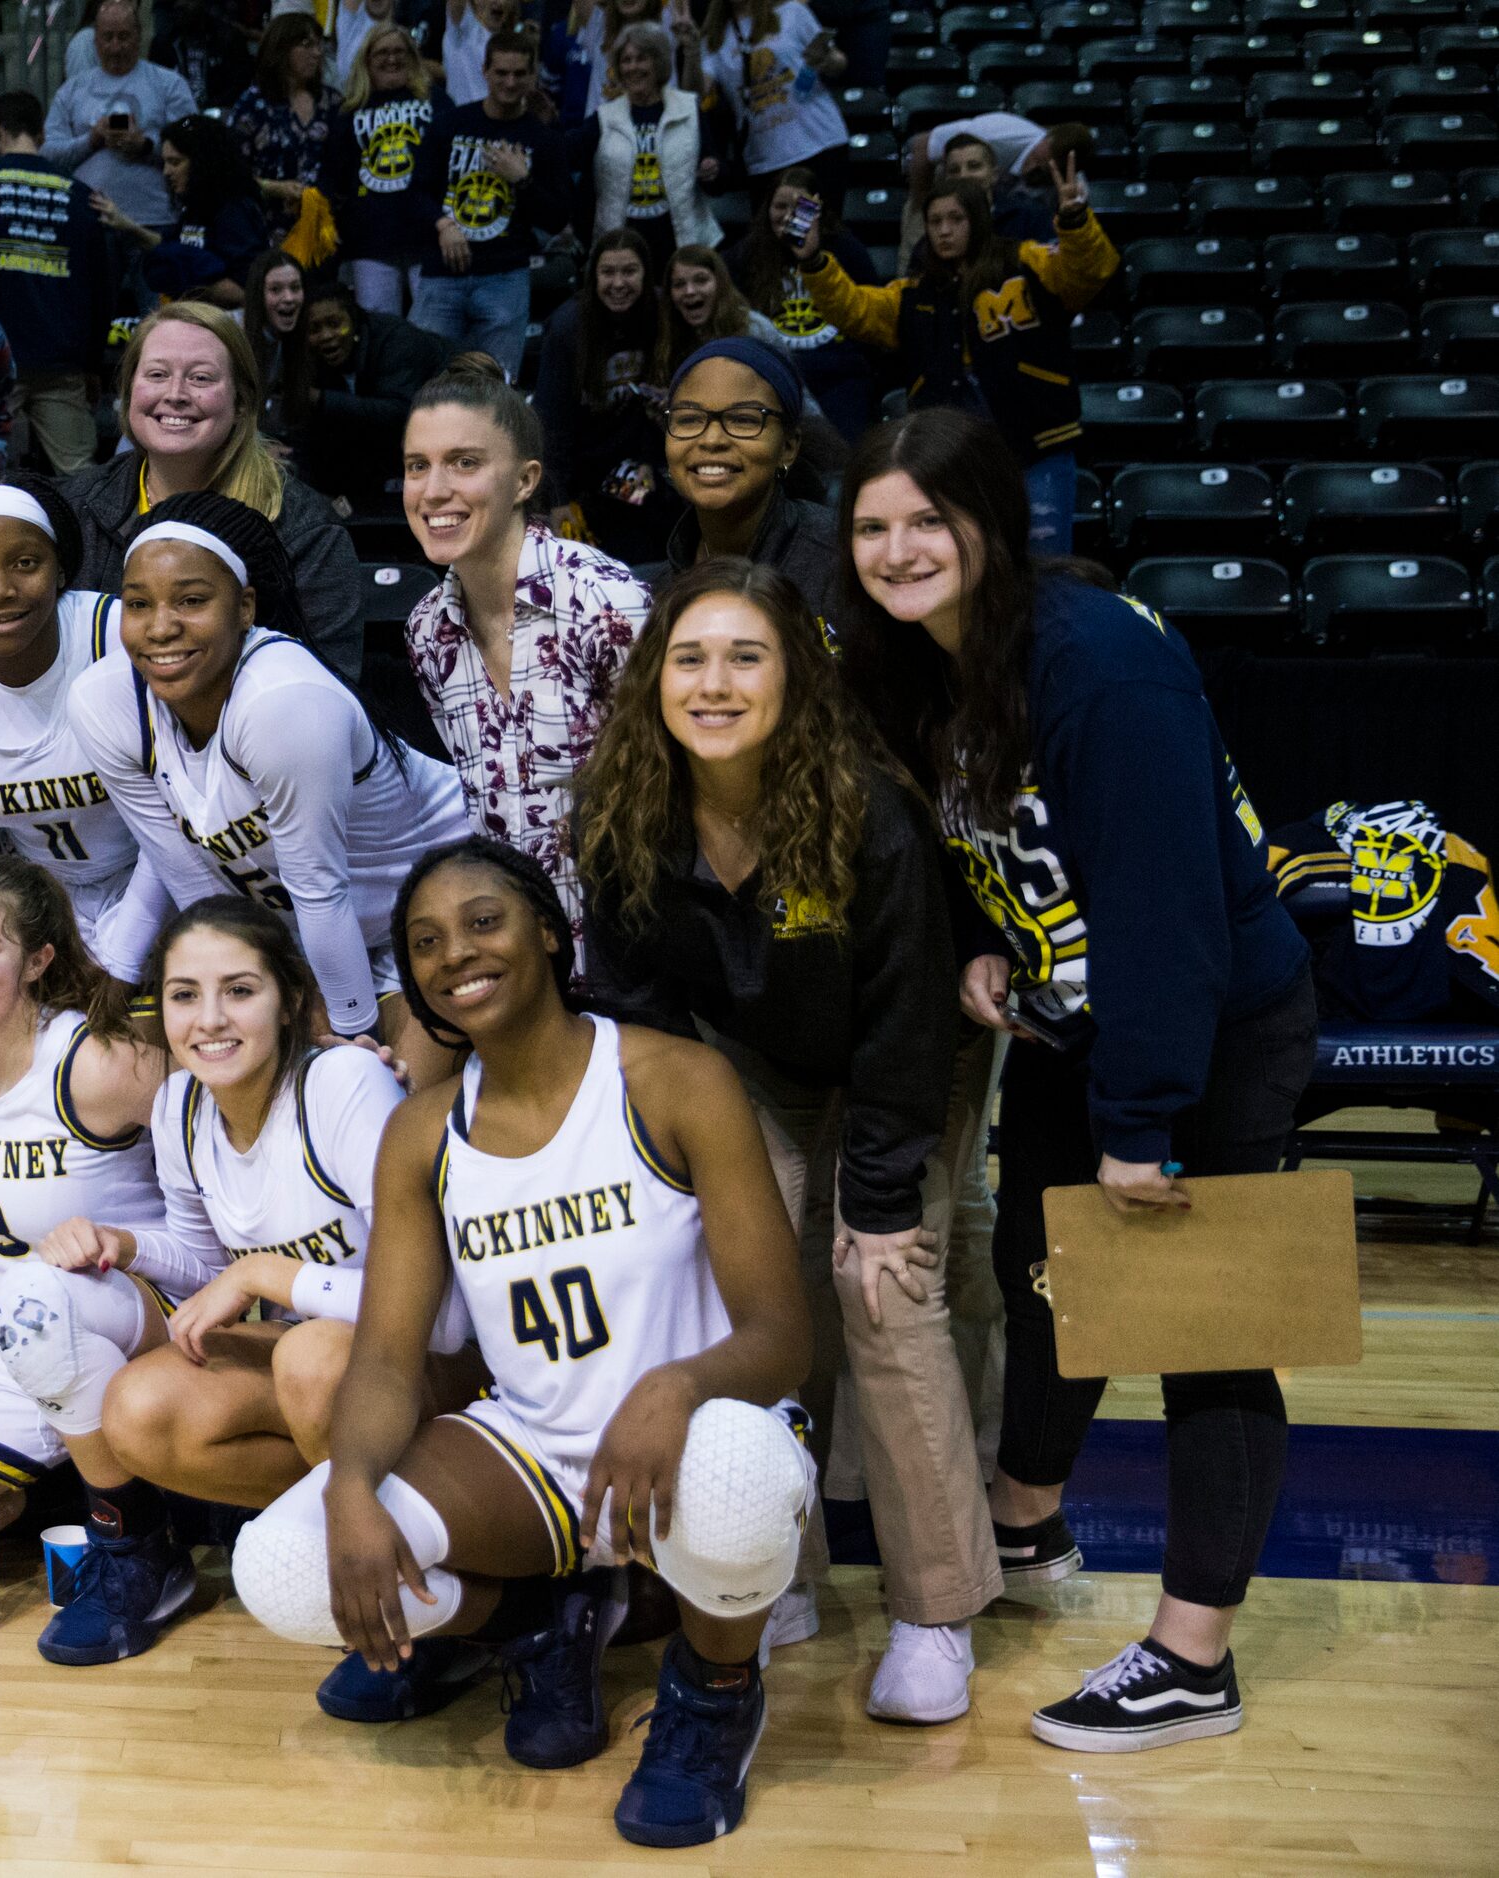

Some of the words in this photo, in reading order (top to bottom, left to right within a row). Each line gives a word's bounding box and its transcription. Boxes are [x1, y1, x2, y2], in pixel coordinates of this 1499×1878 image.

[972, 275, 1040, 343] M
[33, 821, 90, 861] 11
[1352, 863, 1413, 883] LIONS
[1332, 1045, 1495, 1066] ATHLETICS
[452, 1181, 636, 1261] MCKINNEY
[508, 1264, 610, 1362] 40
